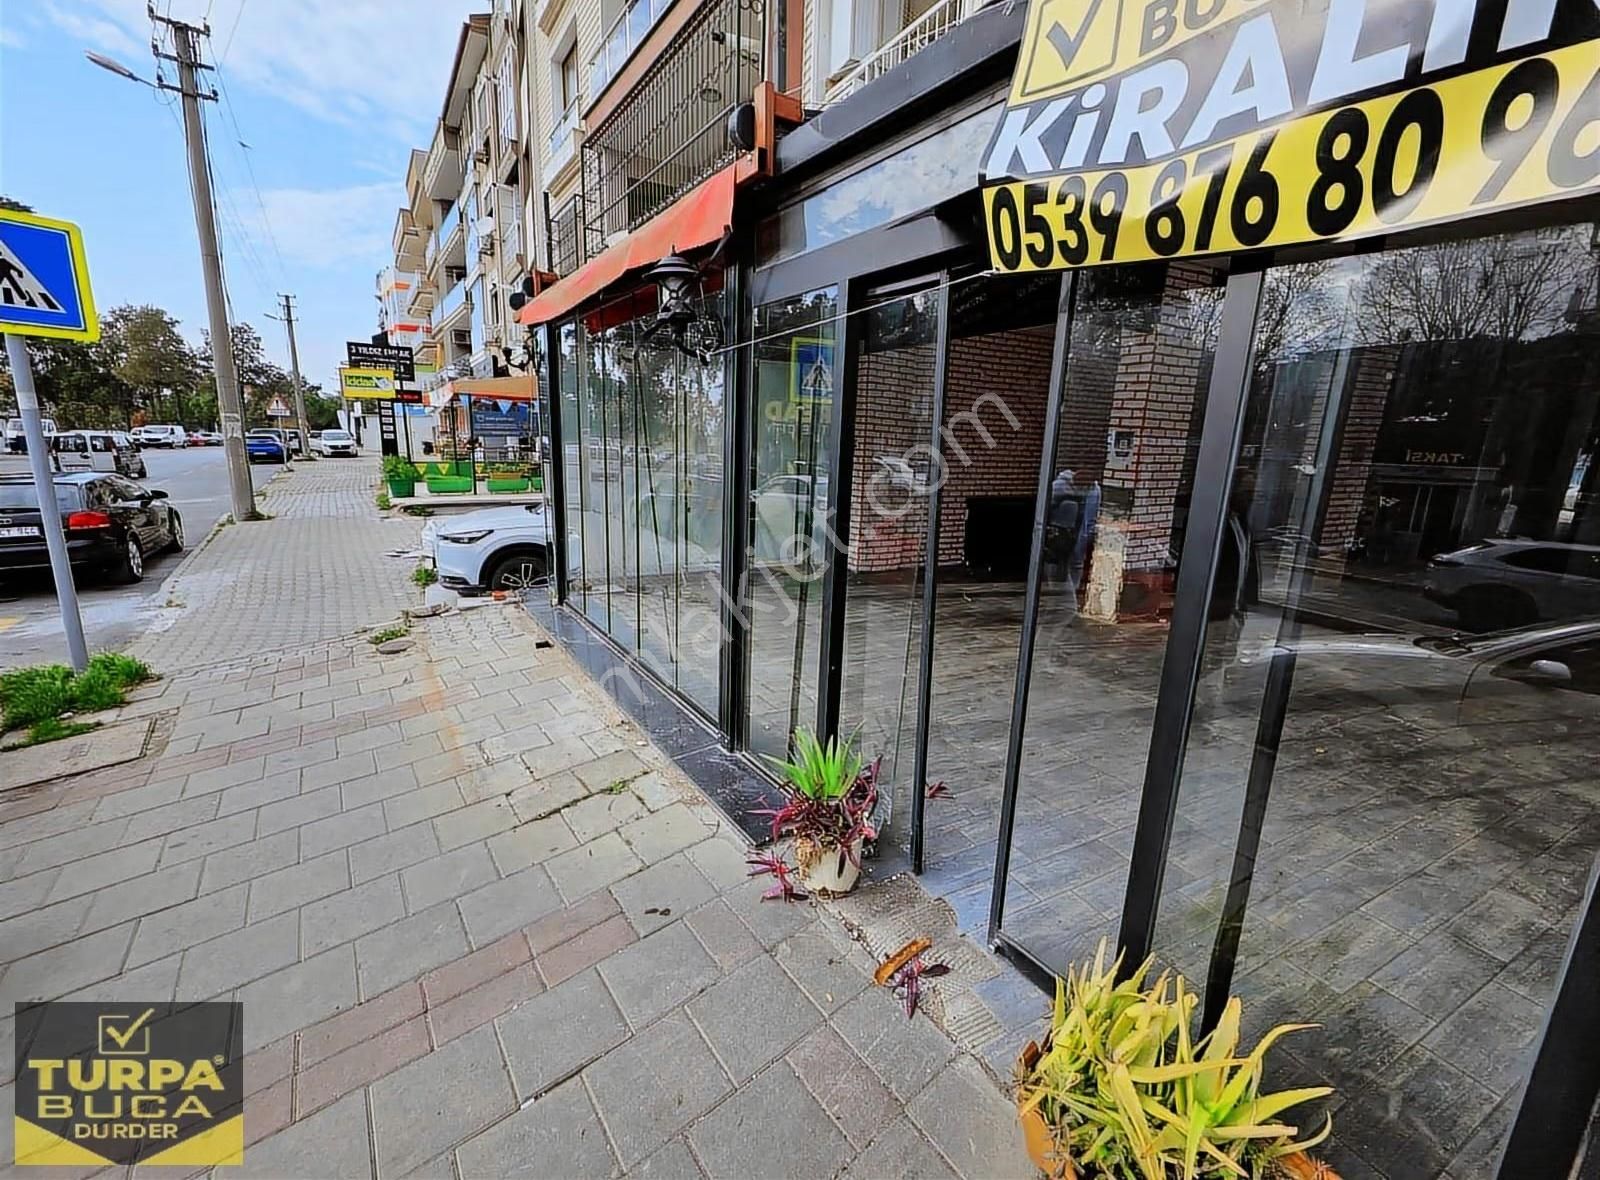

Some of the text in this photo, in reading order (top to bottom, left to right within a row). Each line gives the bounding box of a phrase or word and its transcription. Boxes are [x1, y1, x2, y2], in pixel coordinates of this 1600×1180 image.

[1138, 0, 1258, 57] BU
[991, 57, 1600, 271] 0539 876 80 96
